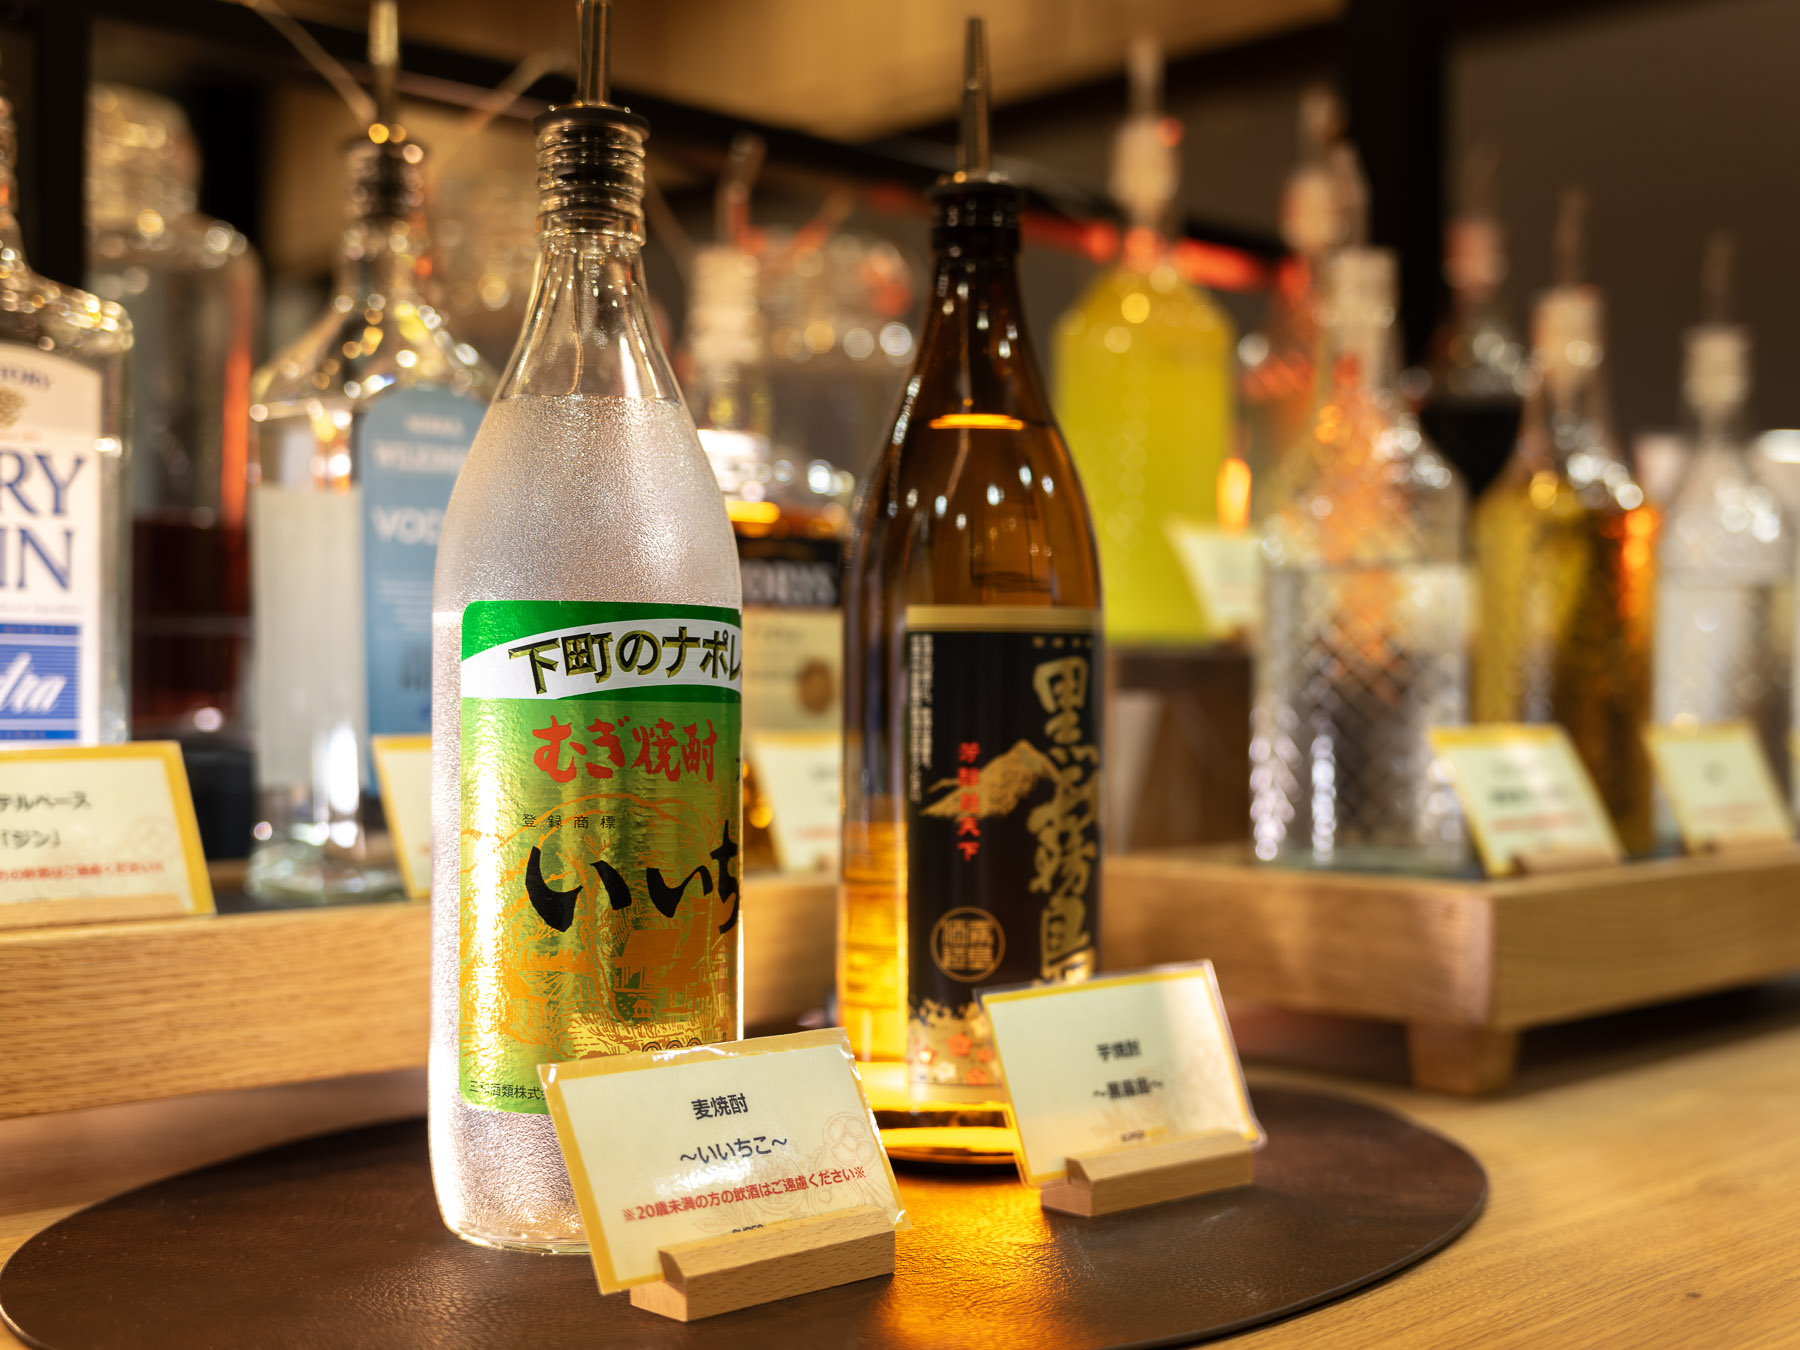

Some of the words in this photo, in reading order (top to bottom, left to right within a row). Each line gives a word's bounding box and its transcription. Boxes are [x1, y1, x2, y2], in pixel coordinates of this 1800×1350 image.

[532, 715, 717, 783] むぎ焼酎
[522, 813, 616, 829] 登録商標
[691, 1092, 749, 1120] 麦焼酎
